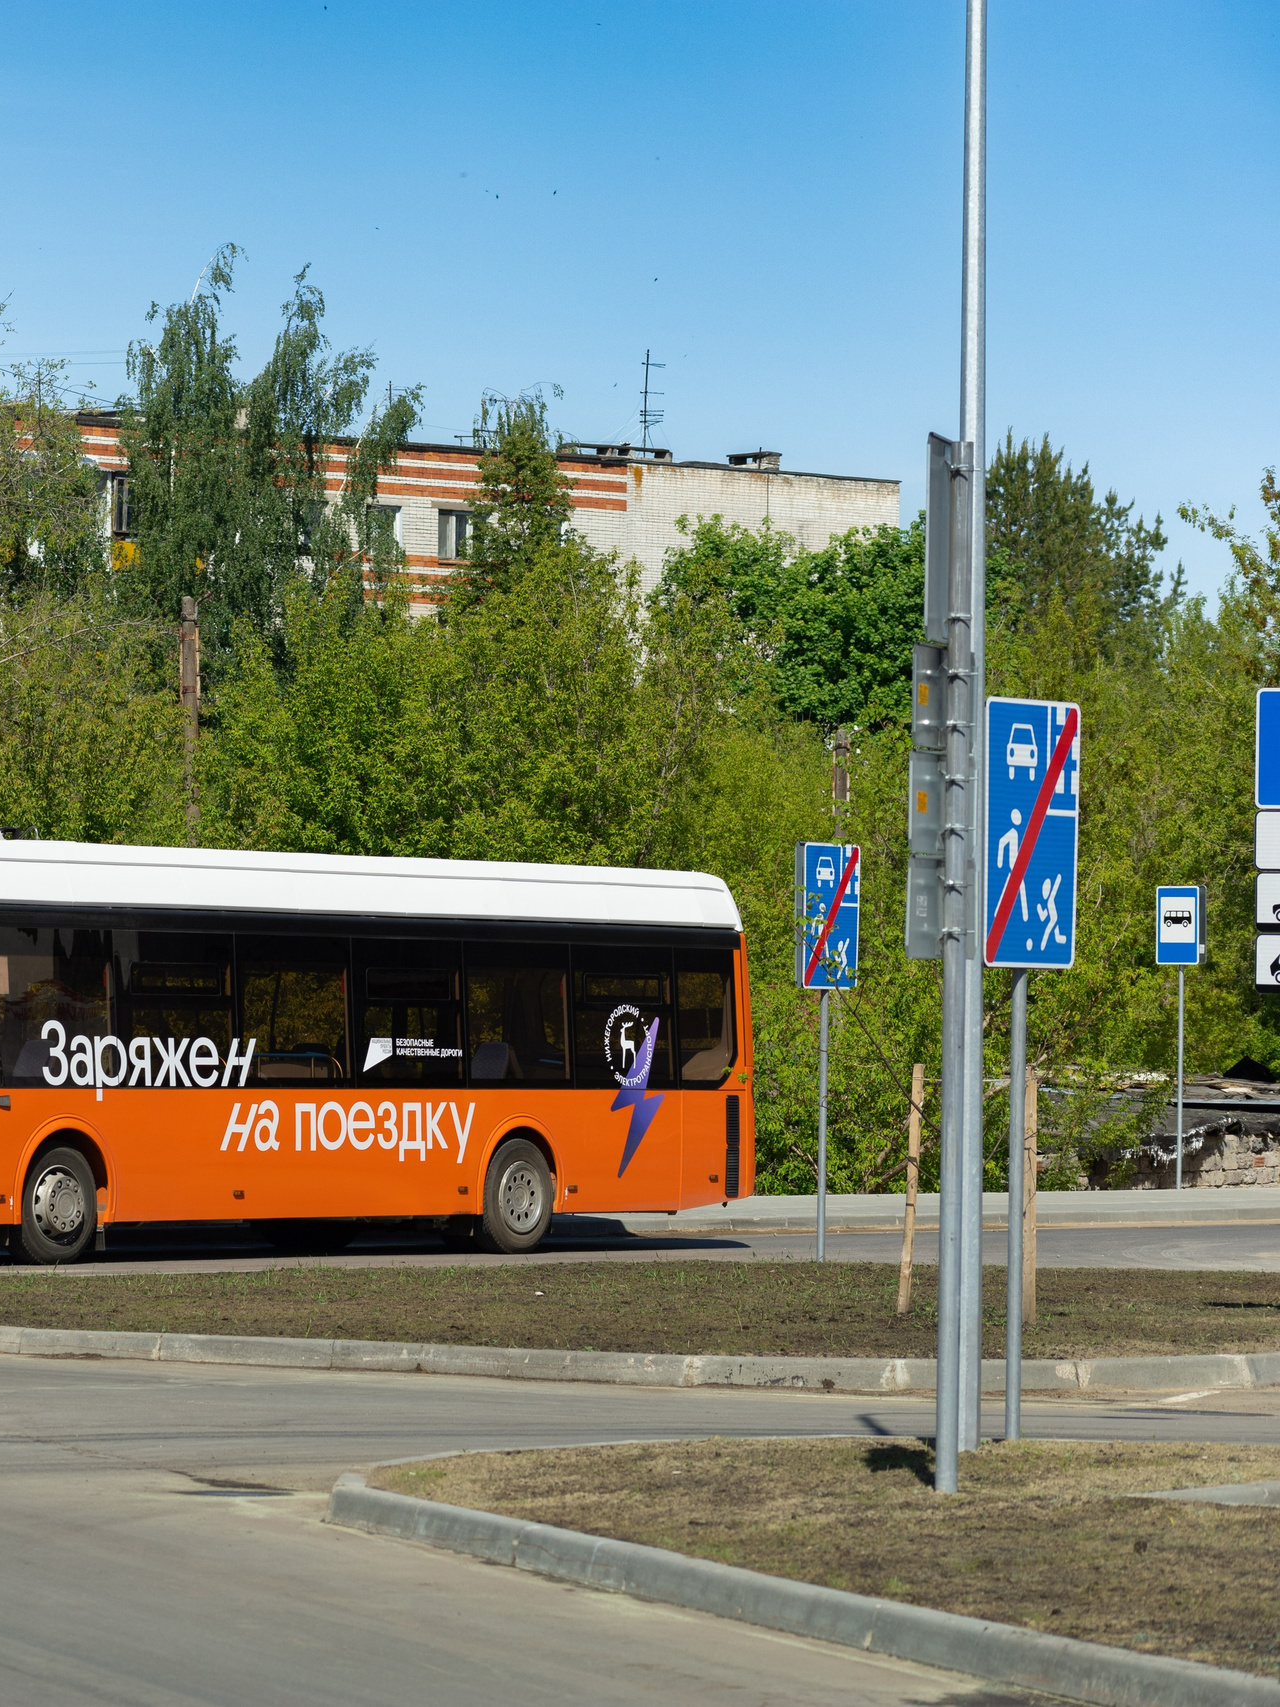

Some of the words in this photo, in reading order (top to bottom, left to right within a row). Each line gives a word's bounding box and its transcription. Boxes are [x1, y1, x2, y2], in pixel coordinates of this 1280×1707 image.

[41, 1019, 257, 1101] Заряжен
[396, 1038, 434, 1047] БЕЗОПАСНЫЕ
[396, 1048, 440, 1057] КАЧЕСТВЕННЫЕ
[440, 1048, 463, 1058] ДОРОГИ
[604, 1004, 640, 1062] НИЖЕГОРОДСКИЙ
[614, 1025, 652, 1087] ЭЛЕКТРОТРАНСПОРТ
[220, 1099, 280, 1152] на
[295, 1100, 476, 1163] поездку
